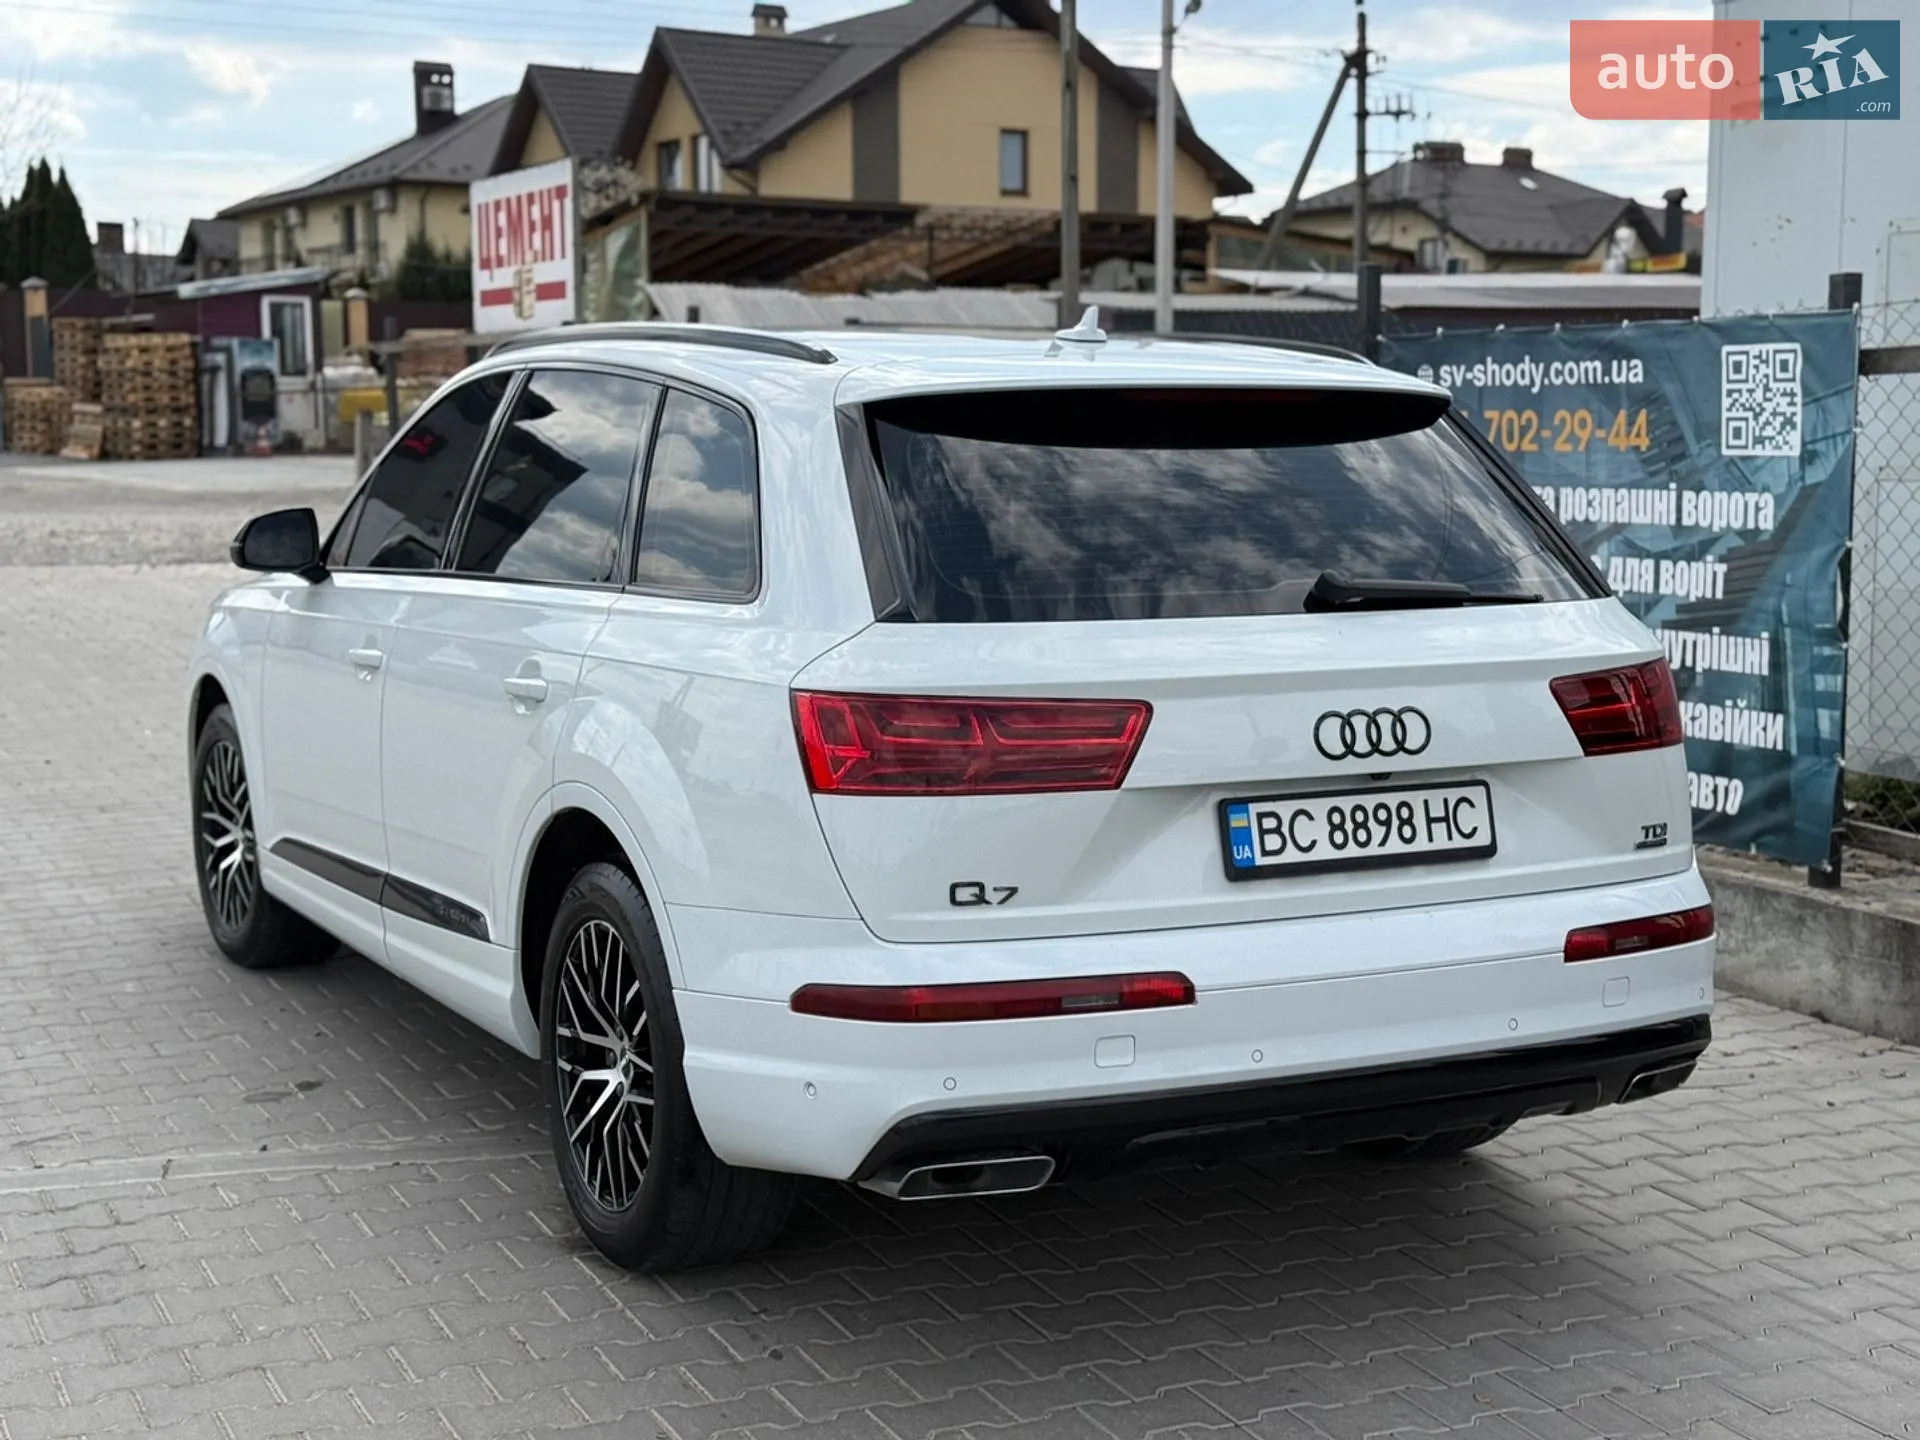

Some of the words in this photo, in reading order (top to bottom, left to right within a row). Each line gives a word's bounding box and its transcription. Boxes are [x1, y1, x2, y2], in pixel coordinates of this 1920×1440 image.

[478, 184, 568, 282] ЦЕМЕНТ
[1439, 354, 1644, 394] sv-shody.com.ua
[1484, 408, 1650, 452] 702-29-44
[1559, 482, 1678, 525] розпашні
[1681, 489, 1775, 532] ворота
[1607, 556, 1655, 597] для
[1659, 554, 1728, 601] воріт
[1687, 771, 1744, 816] авто
[1255, 808, 1318, 858] BC
[1326, 800, 1417, 851] 8898
[1423, 796, 1479, 843] HC
[1233, 845, 1252, 860] UA
[949, 881, 1019, 907] Q7
